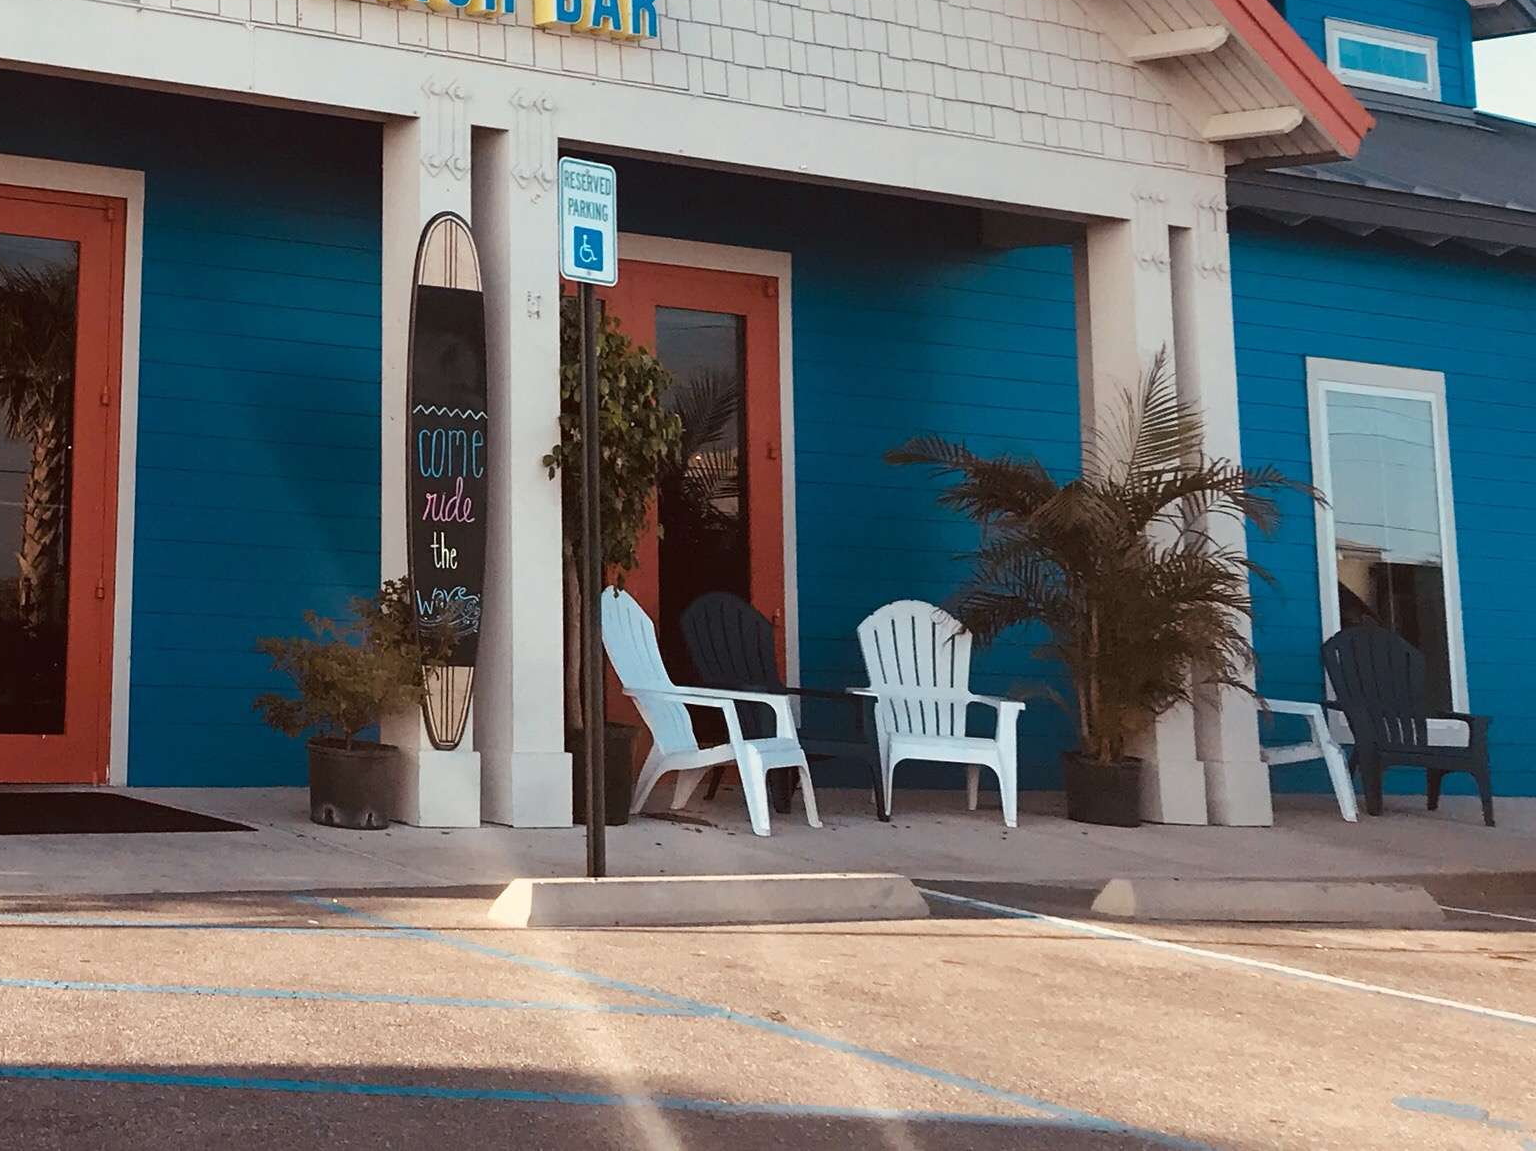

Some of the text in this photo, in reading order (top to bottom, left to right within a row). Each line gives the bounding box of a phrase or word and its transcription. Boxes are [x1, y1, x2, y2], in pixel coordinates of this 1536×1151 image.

[564, 169, 612, 196] RESERVED
[568, 197, 609, 222] PARKING
[418, 428, 484, 479] come
[422, 476, 476, 523] ride
[430, 531, 458, 569] the
